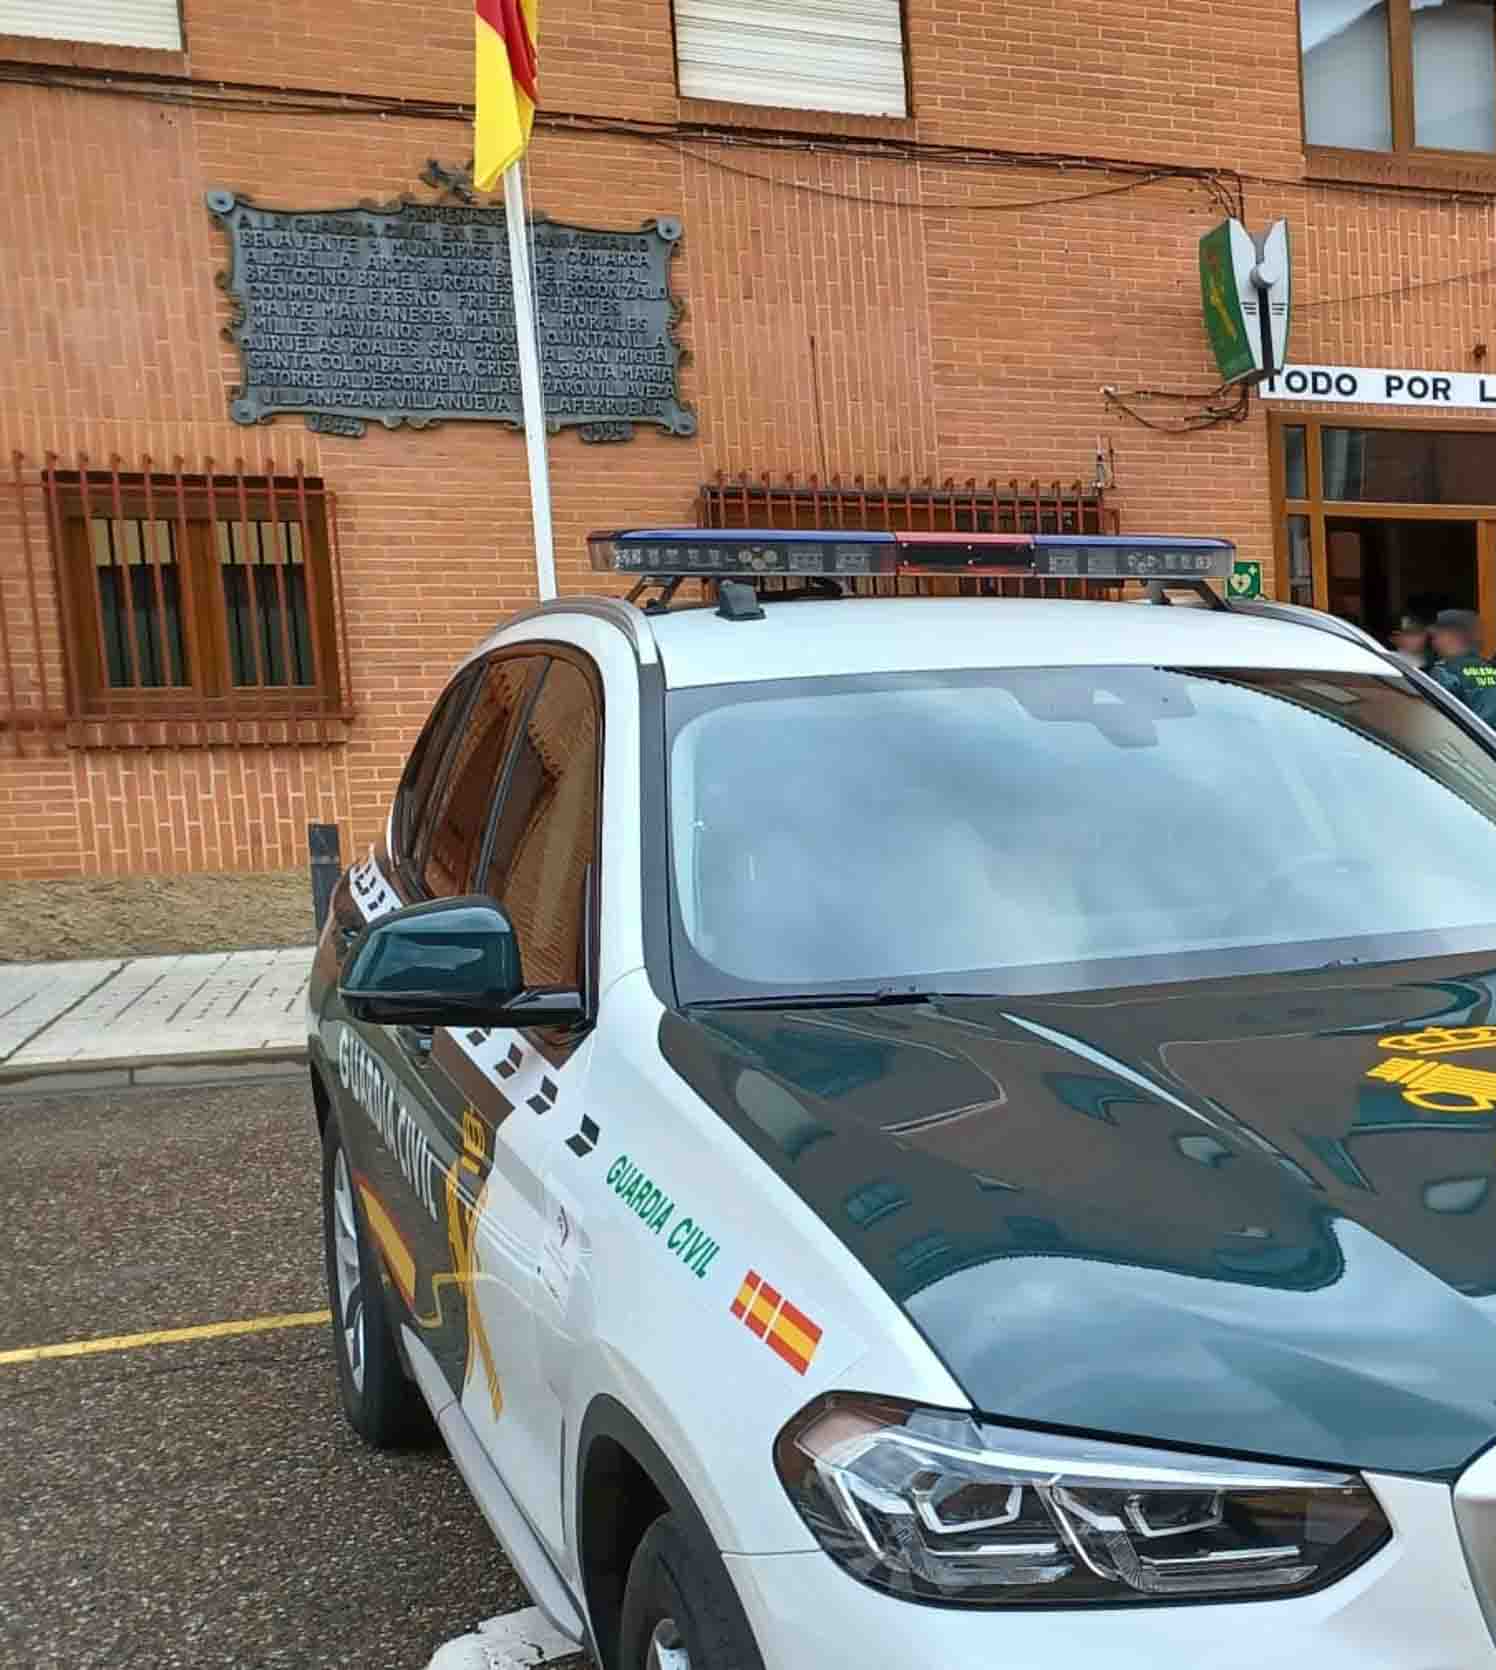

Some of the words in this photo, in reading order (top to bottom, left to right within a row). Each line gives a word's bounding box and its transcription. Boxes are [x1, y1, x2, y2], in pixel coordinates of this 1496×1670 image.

[240, 231, 360, 253] BENAVENTE
[567, 249, 650, 269] COMARCA
[367, 254, 425, 273] ARCOS
[246, 265, 352, 287] BRETOCINO
[359, 270, 413, 289] BRIME
[421, 272, 513, 293] BURGANES
[538, 279, 668, 301] STROGONZALO
[249, 284, 357, 304] COOMONTE
[369, 287, 441, 308] FRESNO
[539, 296, 621, 316] FUENTES
[255, 299, 314, 319] MAIRE
[321, 303, 453, 324] MANGANESES
[561, 314, 649, 336] MORALES
[242, 335, 341, 354] QUIRUELAS
[349, 337, 417, 357] ROALES
[430, 341, 464, 359] SAN
[575, 346, 609, 364] SAN
[616, 349, 672, 367] MIGUEL
[328, 320, 424, 341] NAVIANOS
[433, 326, 515, 346] POBLADU
[544, 330, 666, 351] QUINTANILLA
[249, 352, 313, 370] SANTA
[319, 355, 401, 375] COLOMBA
[415, 359, 471, 378] SANTA
[559, 362, 616, 381] SANTA
[621, 365, 673, 384] MARIA
[262, 388, 385, 409] VILLANAZAR
[396, 391, 513, 413] VILLANUEVA
[269, 370, 323, 389] TORRE
[331, 372, 462, 393] VALDESCORRIEL
[591, 381, 674, 400] VILLAVEZA
[1264, 370, 1358, 396] TODO
[1384, 376, 1452, 401] POR
[338, 1027, 398, 1159] GUARDIA
[397, 1108, 438, 1222] CIVIL
[605, 1154, 673, 1237] GUARDIA
[666, 1217, 721, 1279] CIVIL
